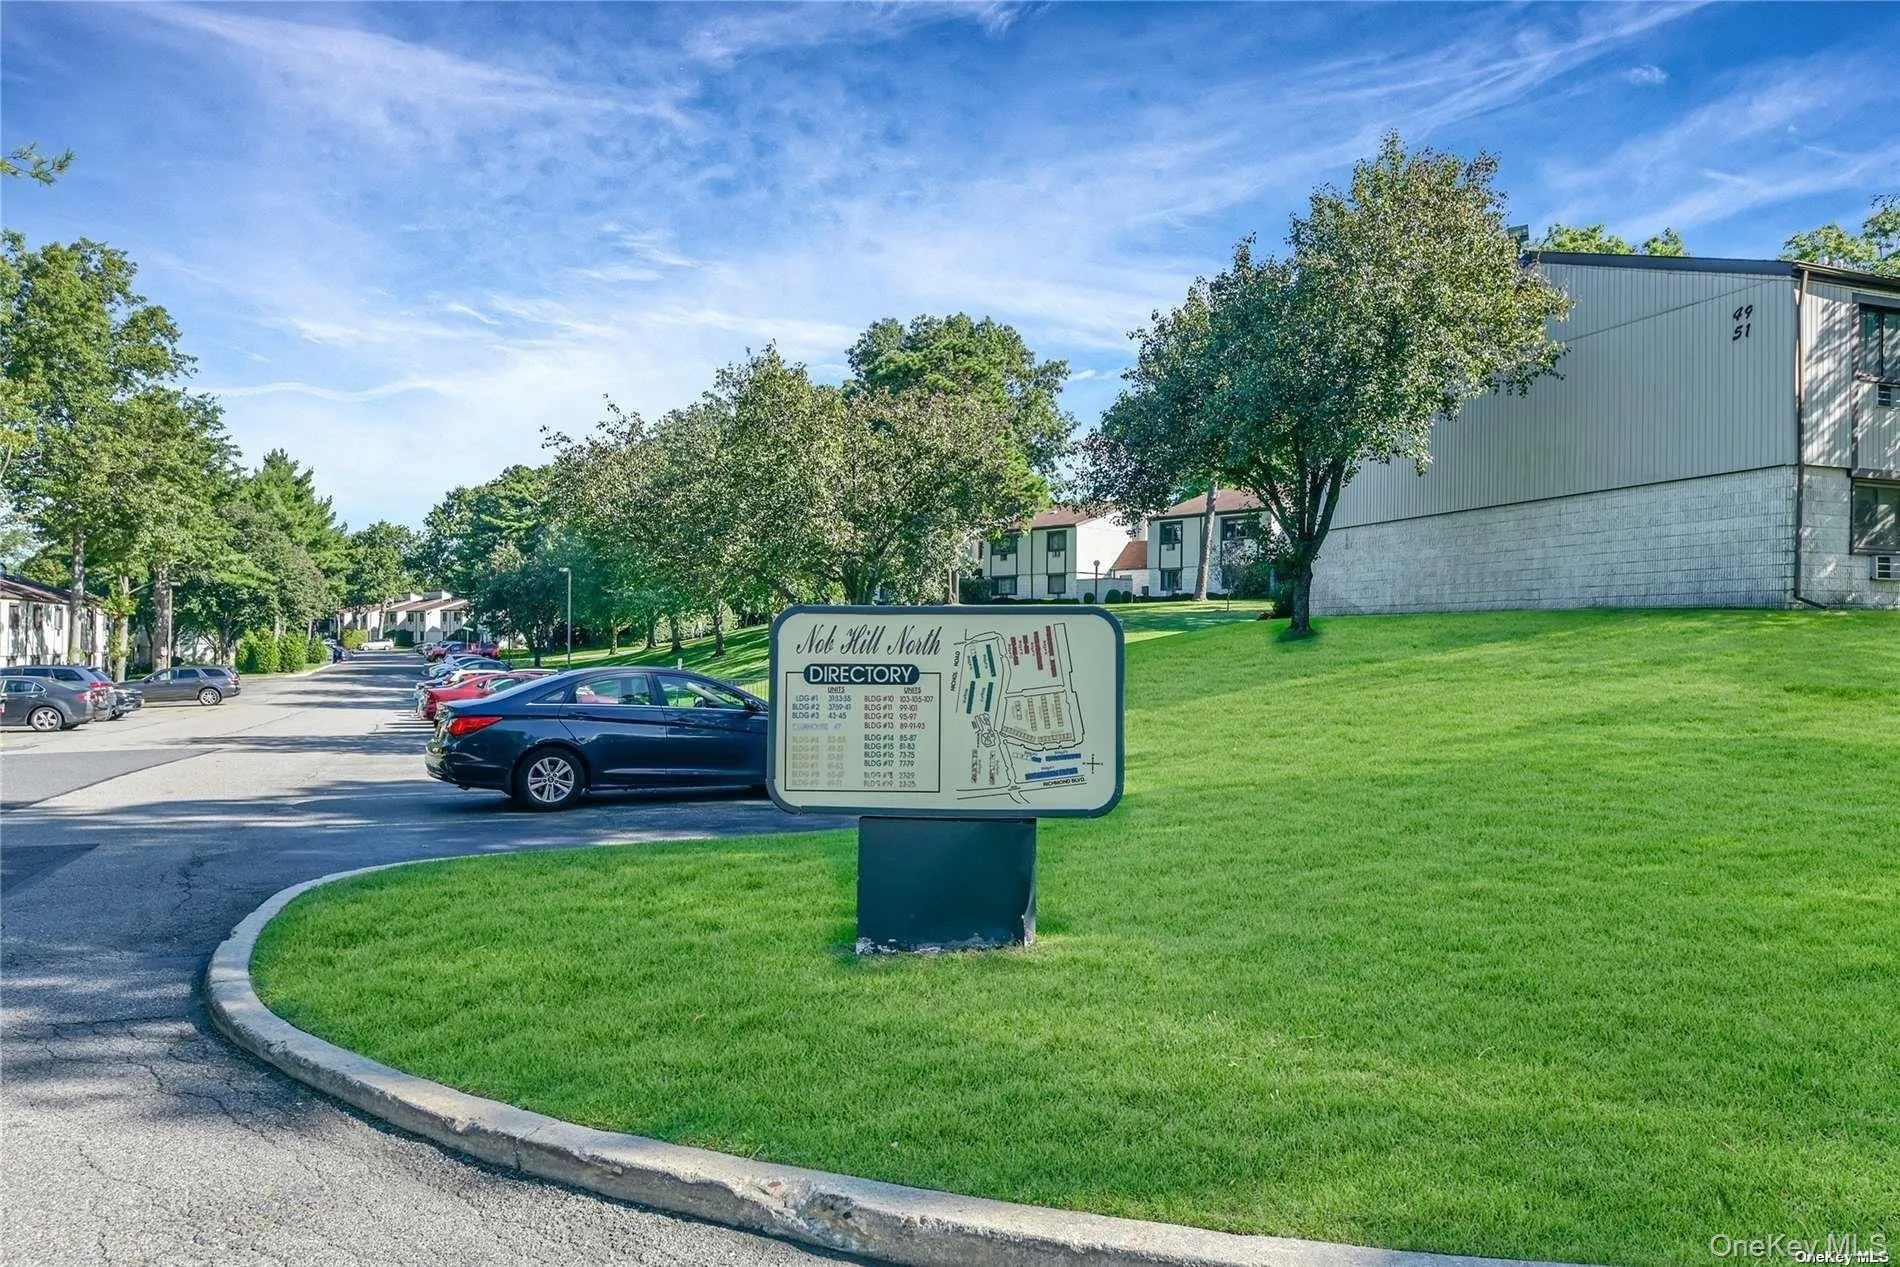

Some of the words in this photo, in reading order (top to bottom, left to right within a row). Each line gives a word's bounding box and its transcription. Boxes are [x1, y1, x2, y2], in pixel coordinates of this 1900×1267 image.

[1733, 304, 1753, 321] 49
[1732, 323, 1751, 341] 51
[796, 624, 837, 655] Nob
[840, 624, 886, 655] Hill
[887, 625, 942, 656] North
[809, 666, 913, 683] DIRECTORY
[828, 686, 845, 694] UNITS
